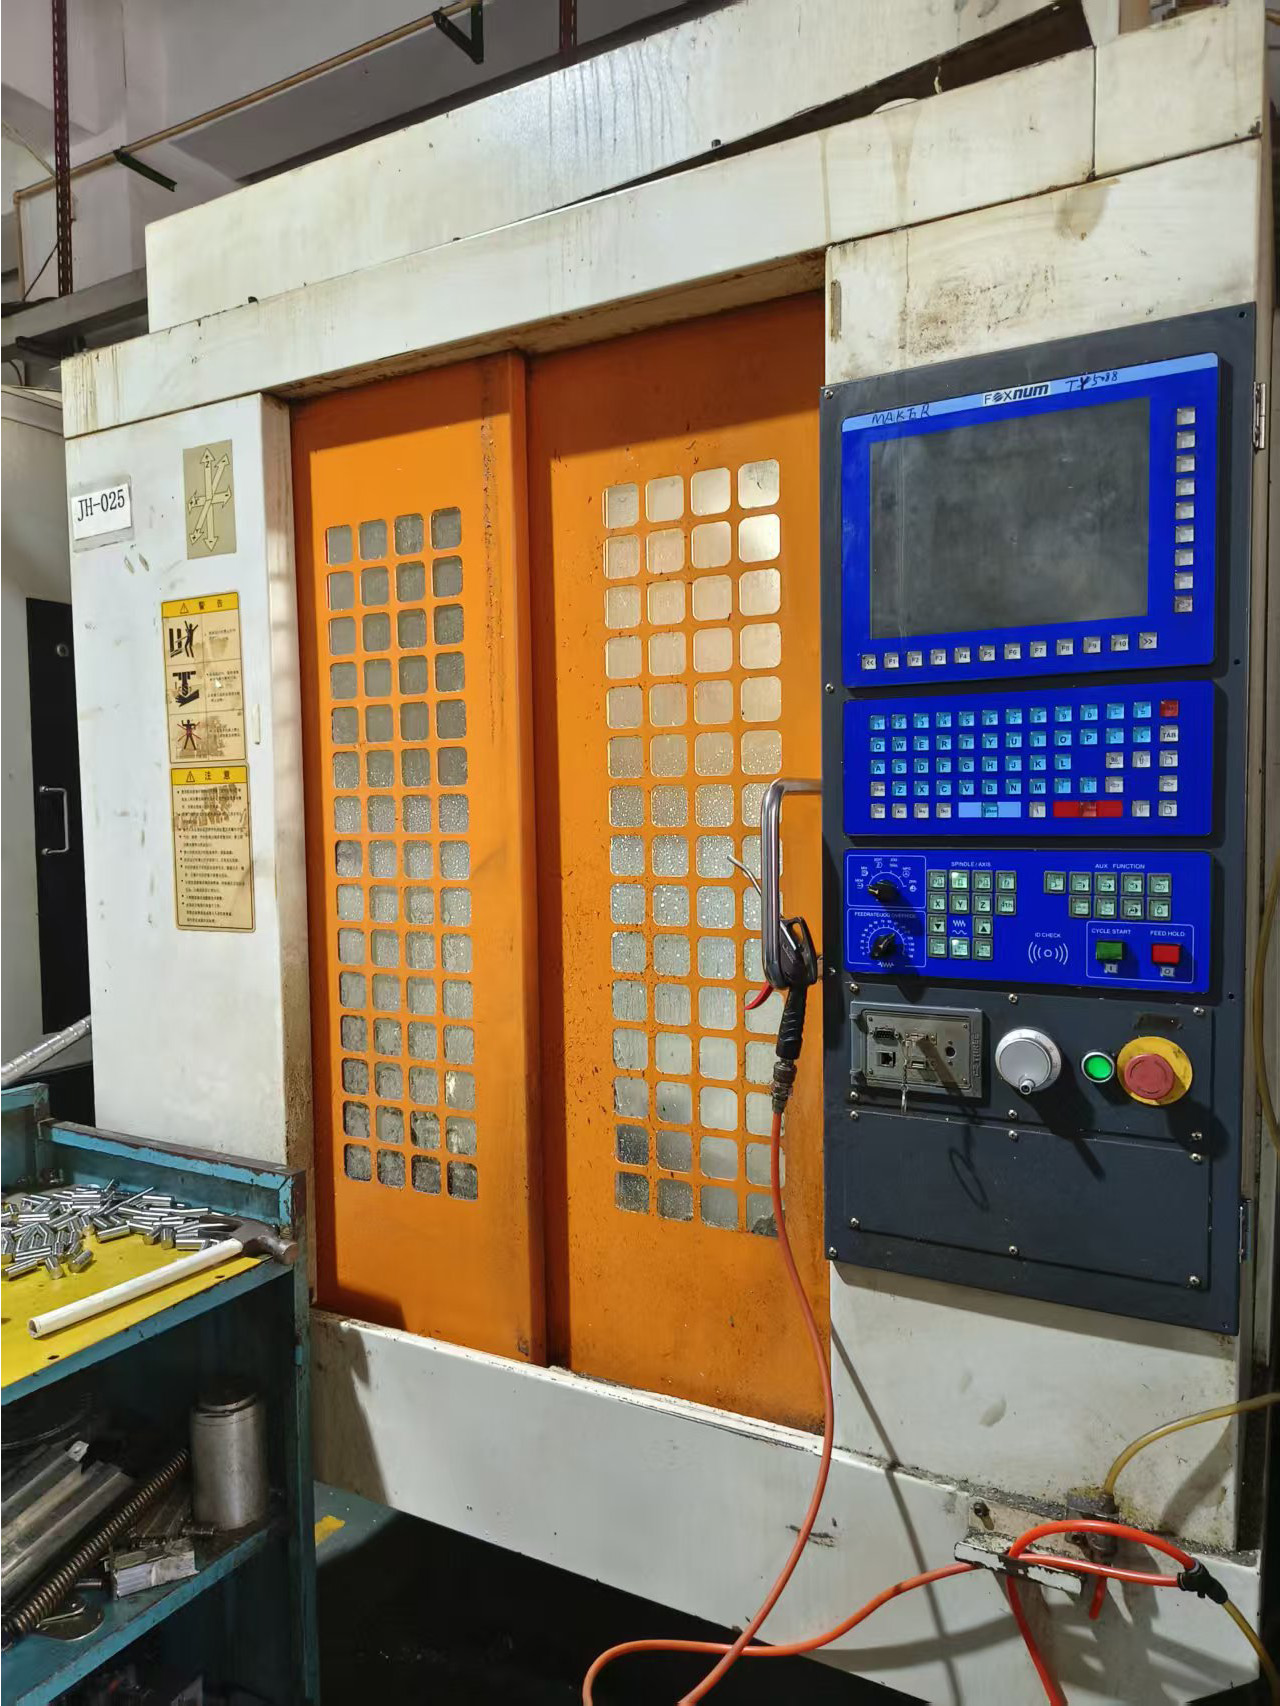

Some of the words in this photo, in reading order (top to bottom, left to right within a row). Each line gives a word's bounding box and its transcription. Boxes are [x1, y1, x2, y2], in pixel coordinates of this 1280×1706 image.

[77, 489, 125, 522] JH-025
[198, 599, 223, 610] 警告
[1060, 736, 1067, 744] O
[1035, 760, 1042, 768] K
[204, 770, 231, 781] 注意
[935, 900, 941, 908] X
[957, 900, 963, 908] Y
